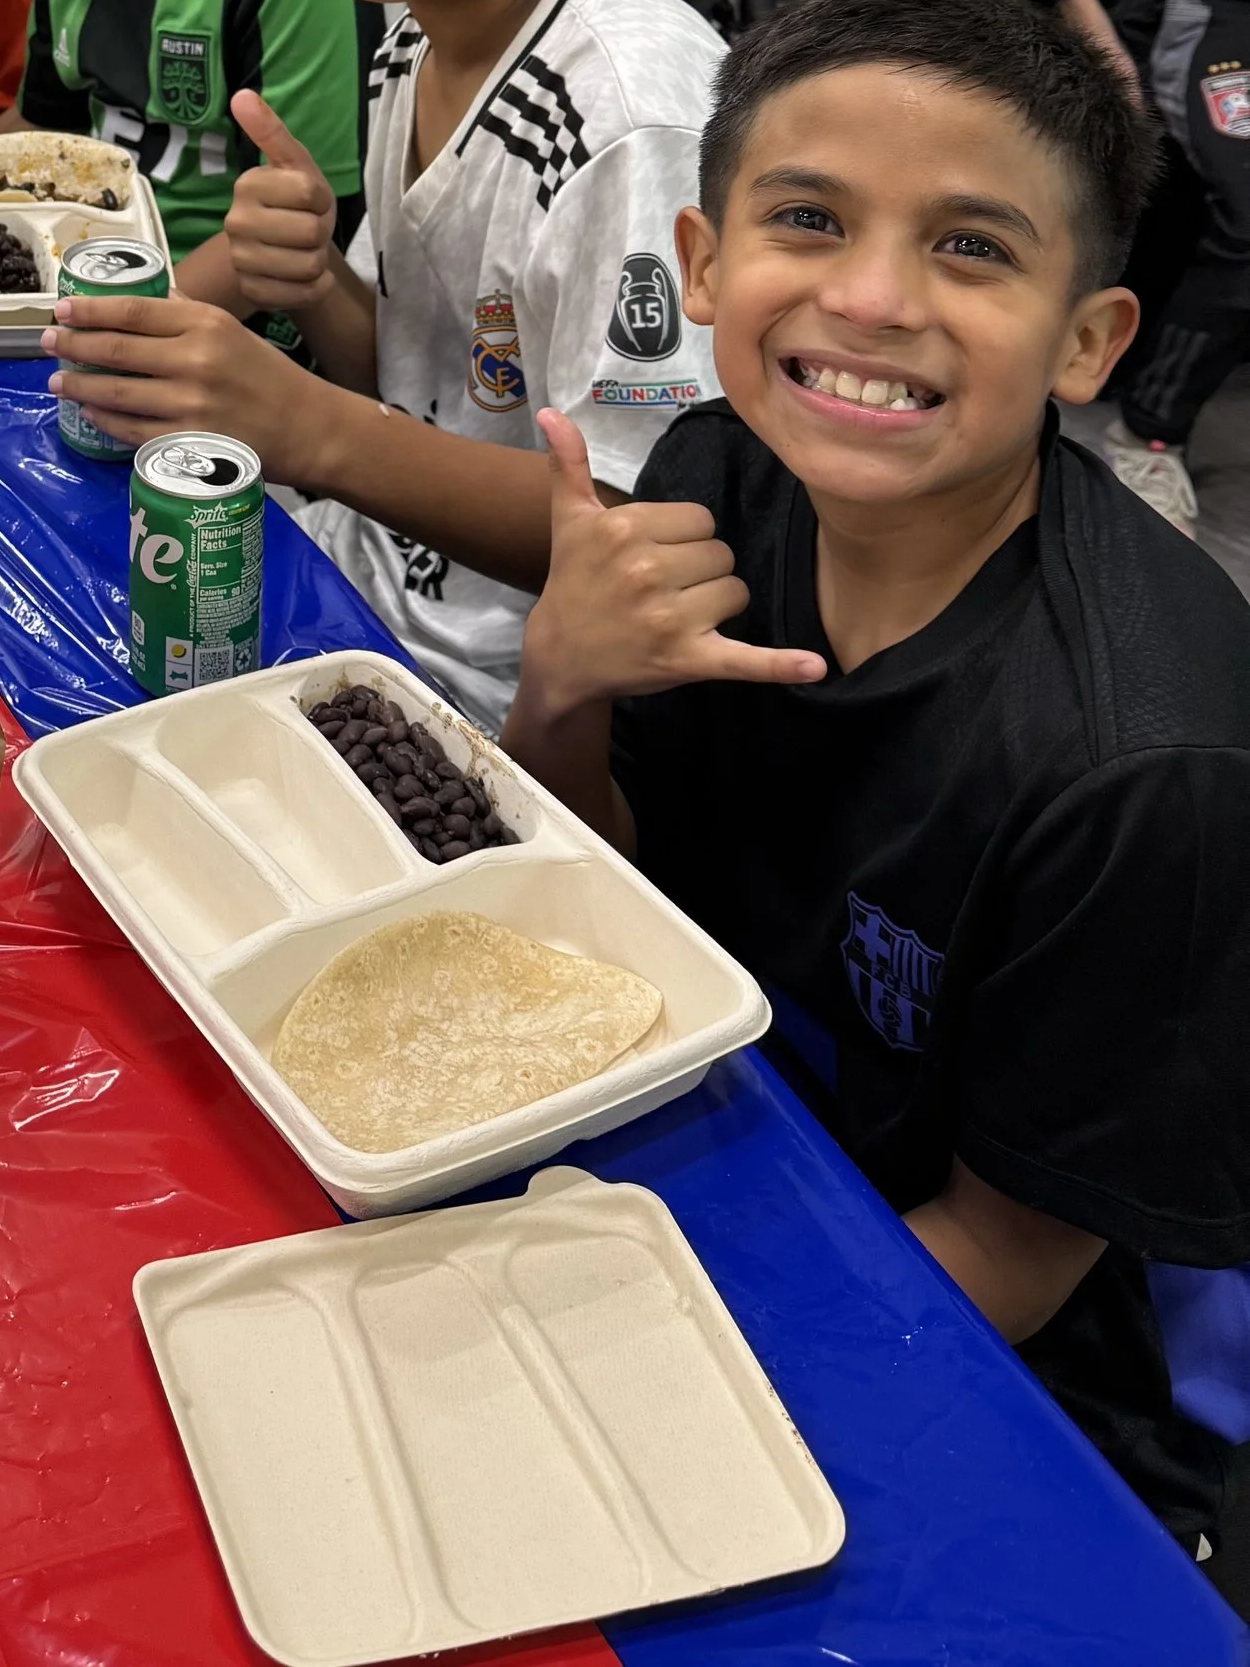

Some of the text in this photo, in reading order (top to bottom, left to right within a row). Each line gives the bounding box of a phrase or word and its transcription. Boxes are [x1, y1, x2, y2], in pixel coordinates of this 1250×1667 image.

[162, 39, 204, 56] AUSTIN
[630, 301, 661, 329] 15
[201, 526, 242, 540] Nutrition
[201, 540, 227, 550] Facts
[200, 588, 227, 597] Calories
